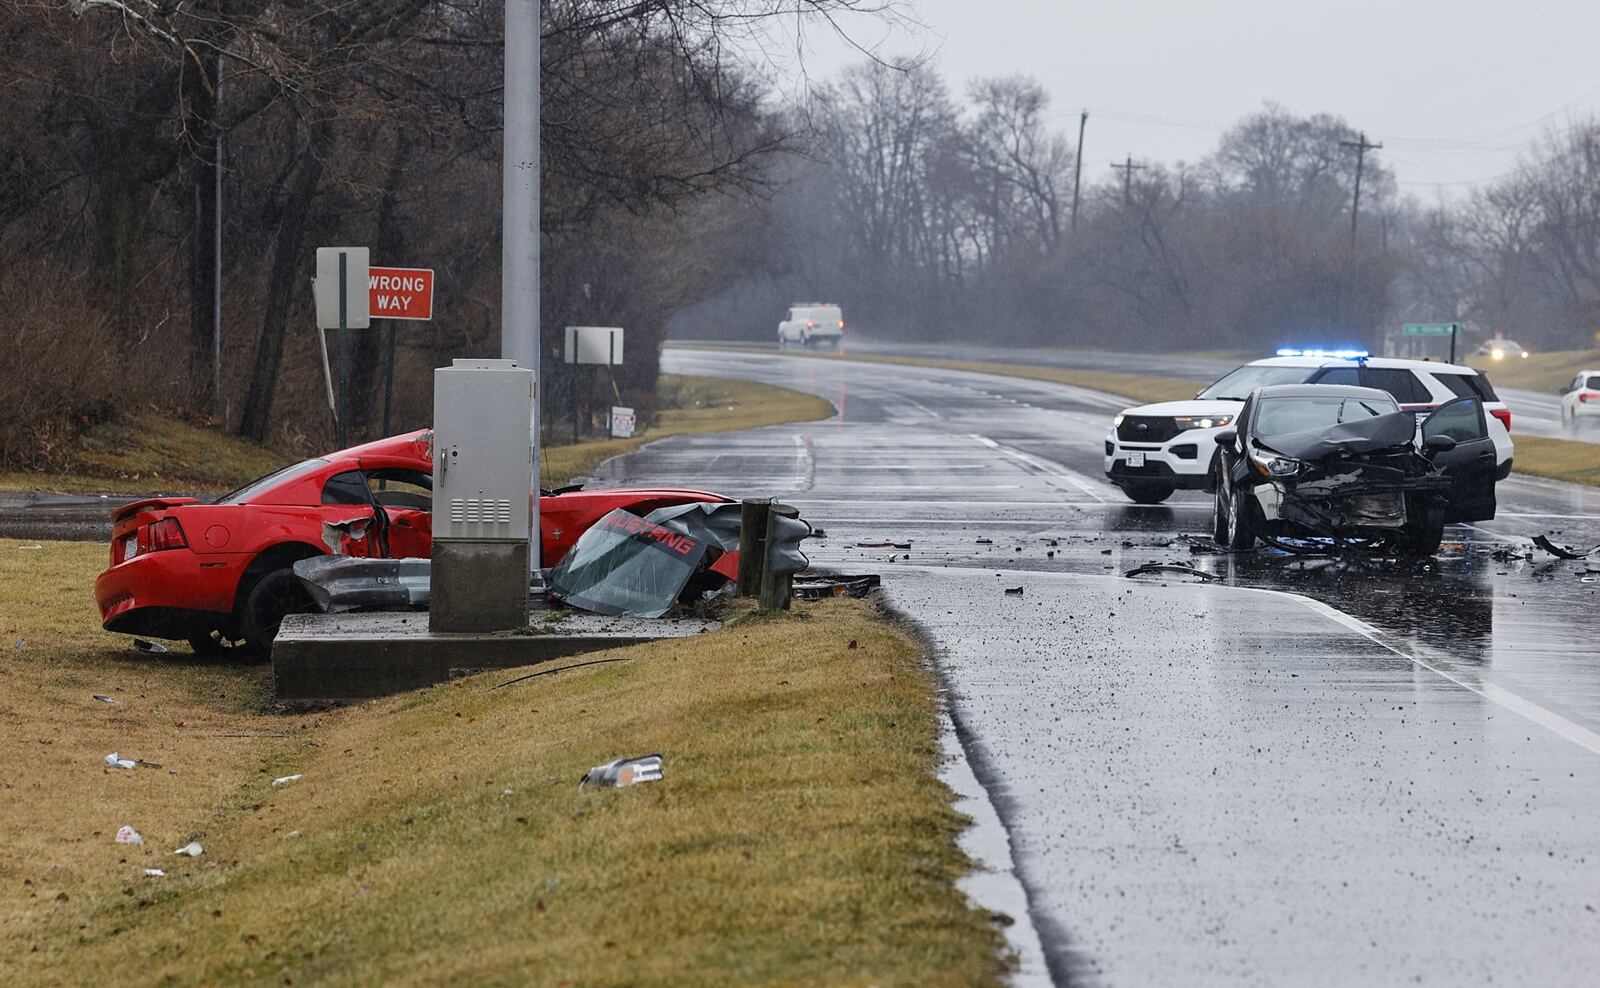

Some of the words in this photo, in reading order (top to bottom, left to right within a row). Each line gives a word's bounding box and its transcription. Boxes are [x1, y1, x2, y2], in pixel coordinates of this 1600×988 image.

[368, 275, 424, 292] WRONG
[377, 295, 412, 310] WAY
[605, 514, 695, 554] MUSTANG
